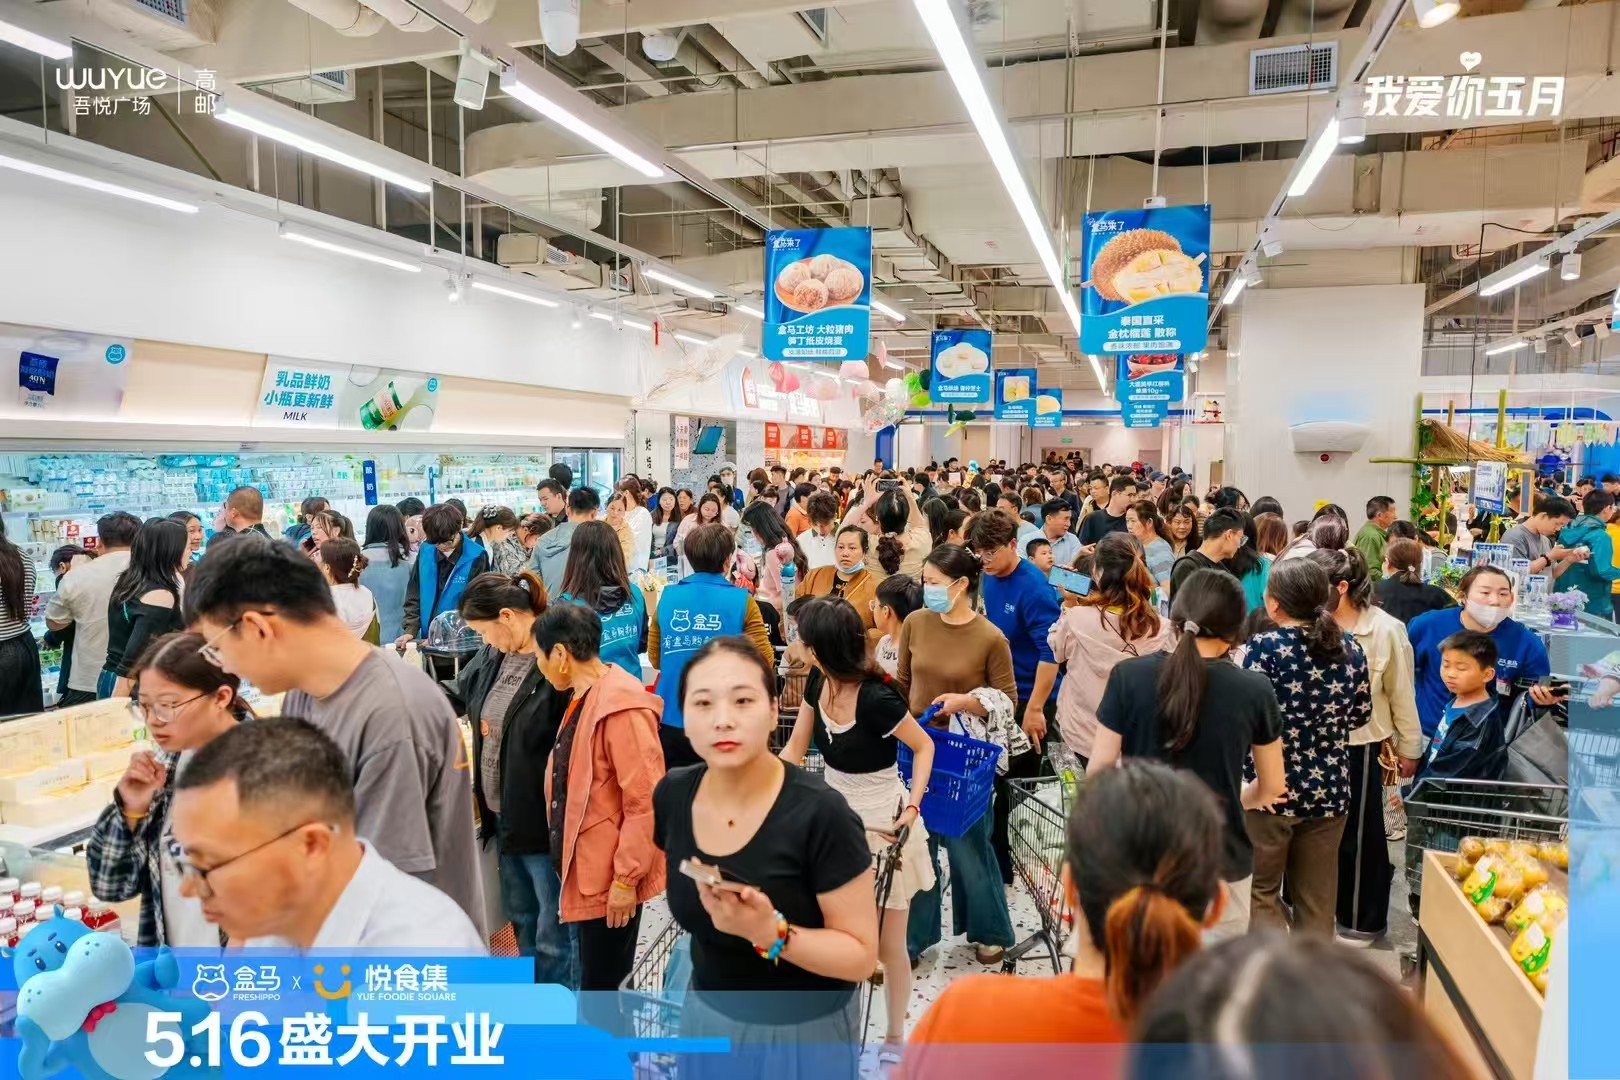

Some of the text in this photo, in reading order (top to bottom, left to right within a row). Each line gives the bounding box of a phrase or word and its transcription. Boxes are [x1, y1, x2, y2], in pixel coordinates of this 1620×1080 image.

[1120, 315, 1165, 326] 泰国直采
[778, 324, 854, 335] 盒马工坊 大粒猪肉
[1108, 328, 1152, 339] 金枕榴莲
[275, 370, 331, 390] 乳品鲜奶
[264, 389, 334, 409] 小瓶更新鲜
[283, 411, 308, 421] MILK
[692, 613, 722, 631] 盒马
